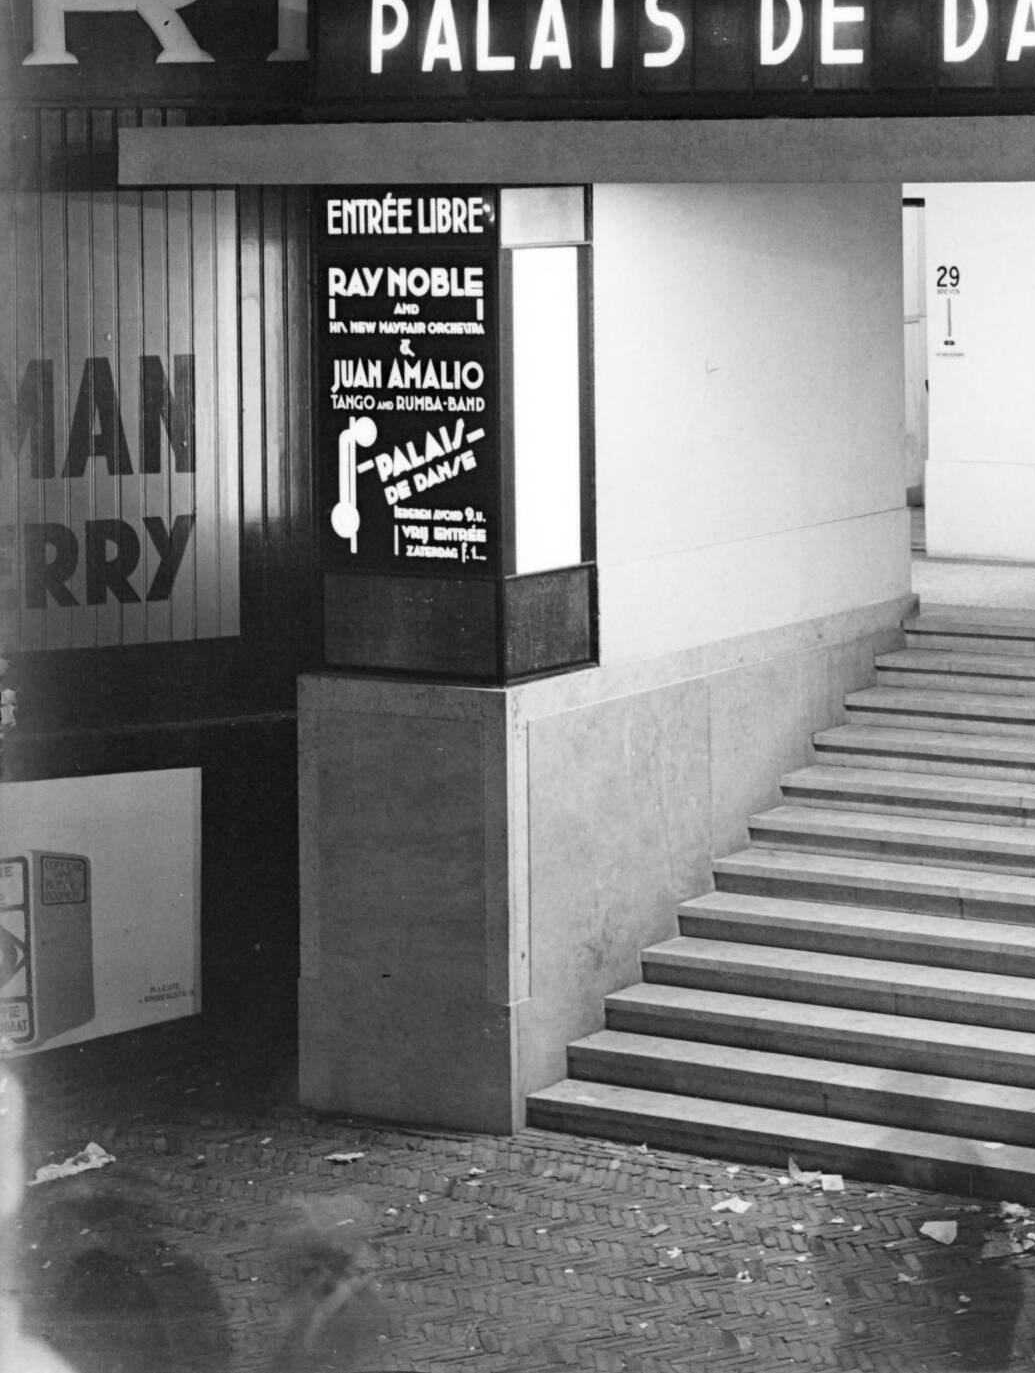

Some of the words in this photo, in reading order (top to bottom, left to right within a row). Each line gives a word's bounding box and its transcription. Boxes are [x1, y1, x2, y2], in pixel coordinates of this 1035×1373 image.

[327, 192, 413, 235] ENTRÉE
[417, 197, 484, 234] LIBRE
[328, 267, 384, 297] RAY
[387, 266, 484, 297] NOBLE
[936, 265, 960, 288] 29
[393, 302, 420, 315] AND
[329, 321, 348, 334] HIS
[350, 321, 377, 334] NEW
[379, 321, 427, 335] MAYFAIR
[427, 321, 485, 335] ORCHESTRA
[399, 338, 416, 357] &
[330, 358, 382, 394] JUAN
[387, 358, 484, 390] AMALIO
[330, 394, 376, 410] TANGO
[376, 400, 394, 411] AND
[396, 396, 486, 412] RUMBA-BAND
[375, 418, 465, 483] PALAIS
[384, 479, 413, 506] DE
[413, 449, 478, 492] DANSE
[433, 509, 463, 522] AVOND
[433, 524, 487, 543] ENTRÉE
[405, 544, 459, 559] ZATERDAG
